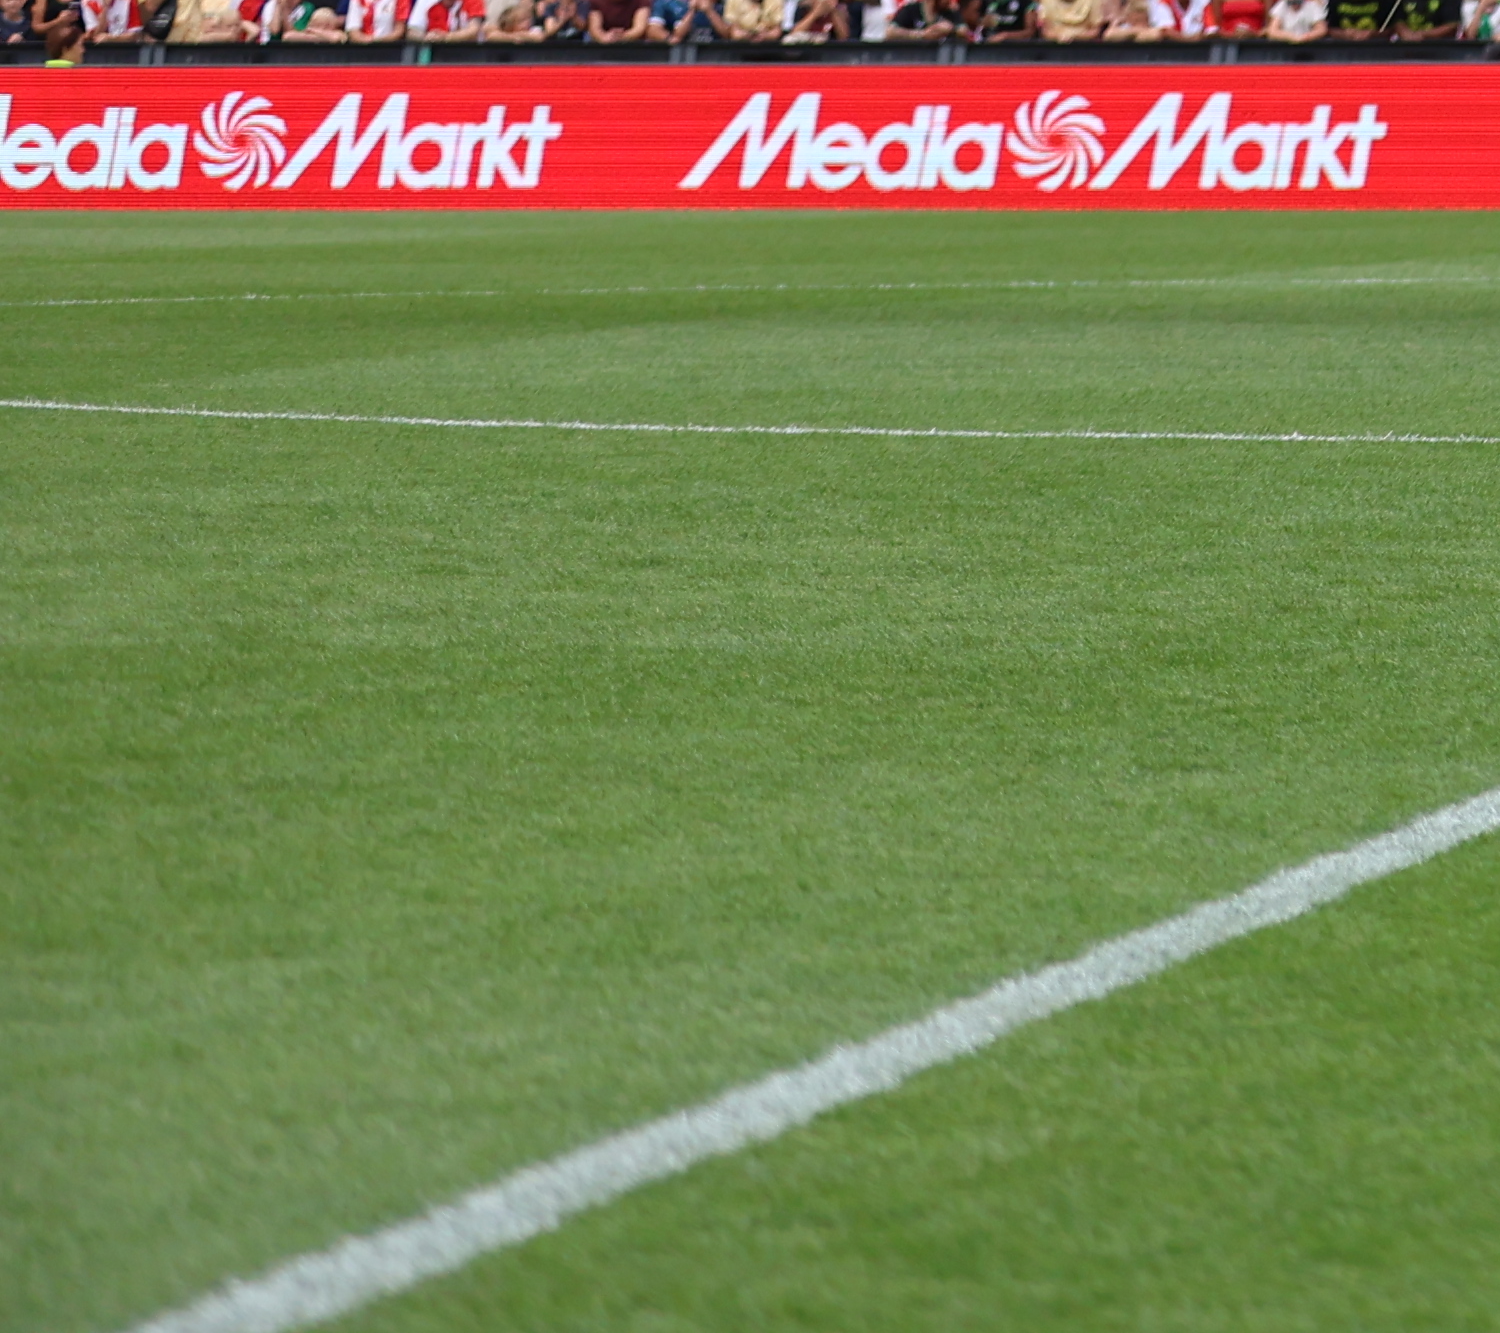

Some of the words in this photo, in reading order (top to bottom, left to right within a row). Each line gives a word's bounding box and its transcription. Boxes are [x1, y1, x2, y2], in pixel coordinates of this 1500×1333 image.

[0, 93, 188, 191] edia
[270, 91, 563, 191] Markt
[678, 92, 1003, 191] Media
[1087, 91, 1388, 191] Markt
